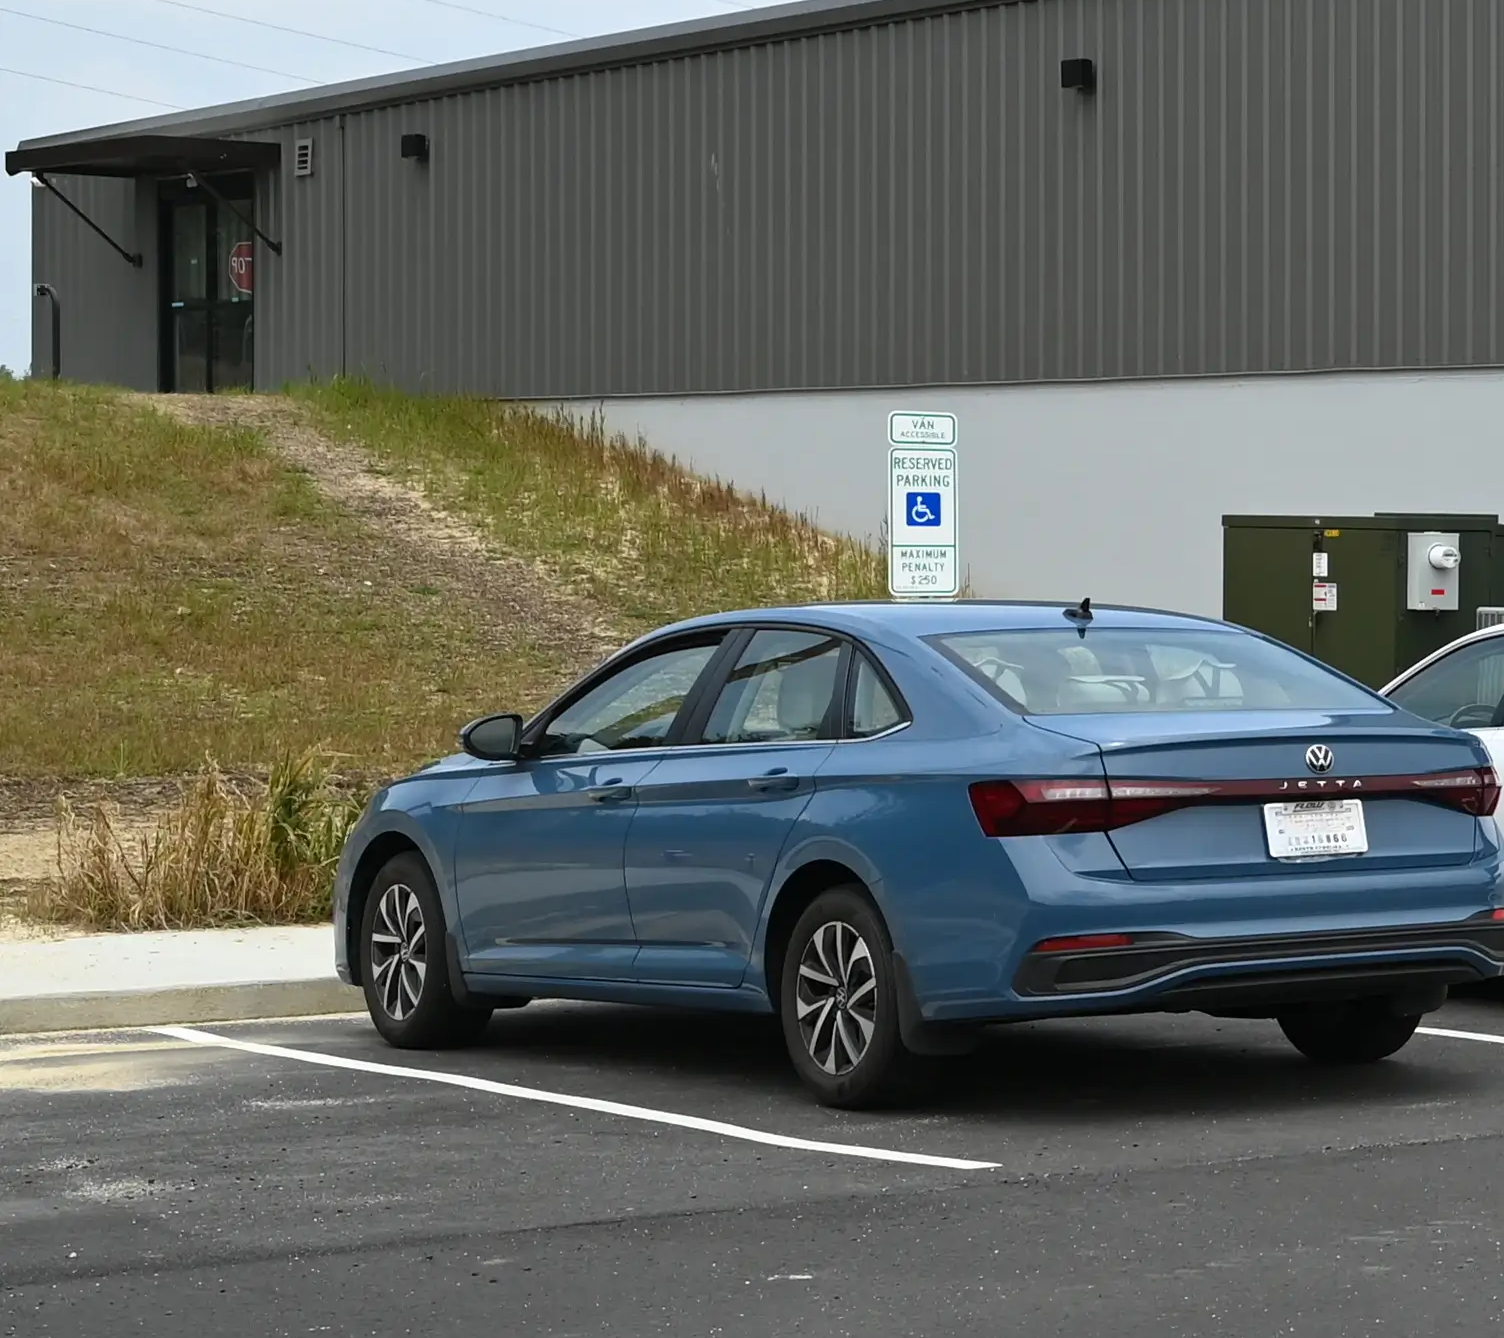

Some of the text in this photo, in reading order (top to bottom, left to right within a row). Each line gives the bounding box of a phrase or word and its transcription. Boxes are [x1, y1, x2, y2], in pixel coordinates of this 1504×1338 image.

[911, 420, 935, 429] VAN
[893, 457, 953, 470] RESERVED
[896, 474, 950, 487] PARKING
[900, 549, 947, 559] MAXIMUM
[902, 562, 945, 572] PENALTY
[1279, 779, 1362, 790] JETTA
